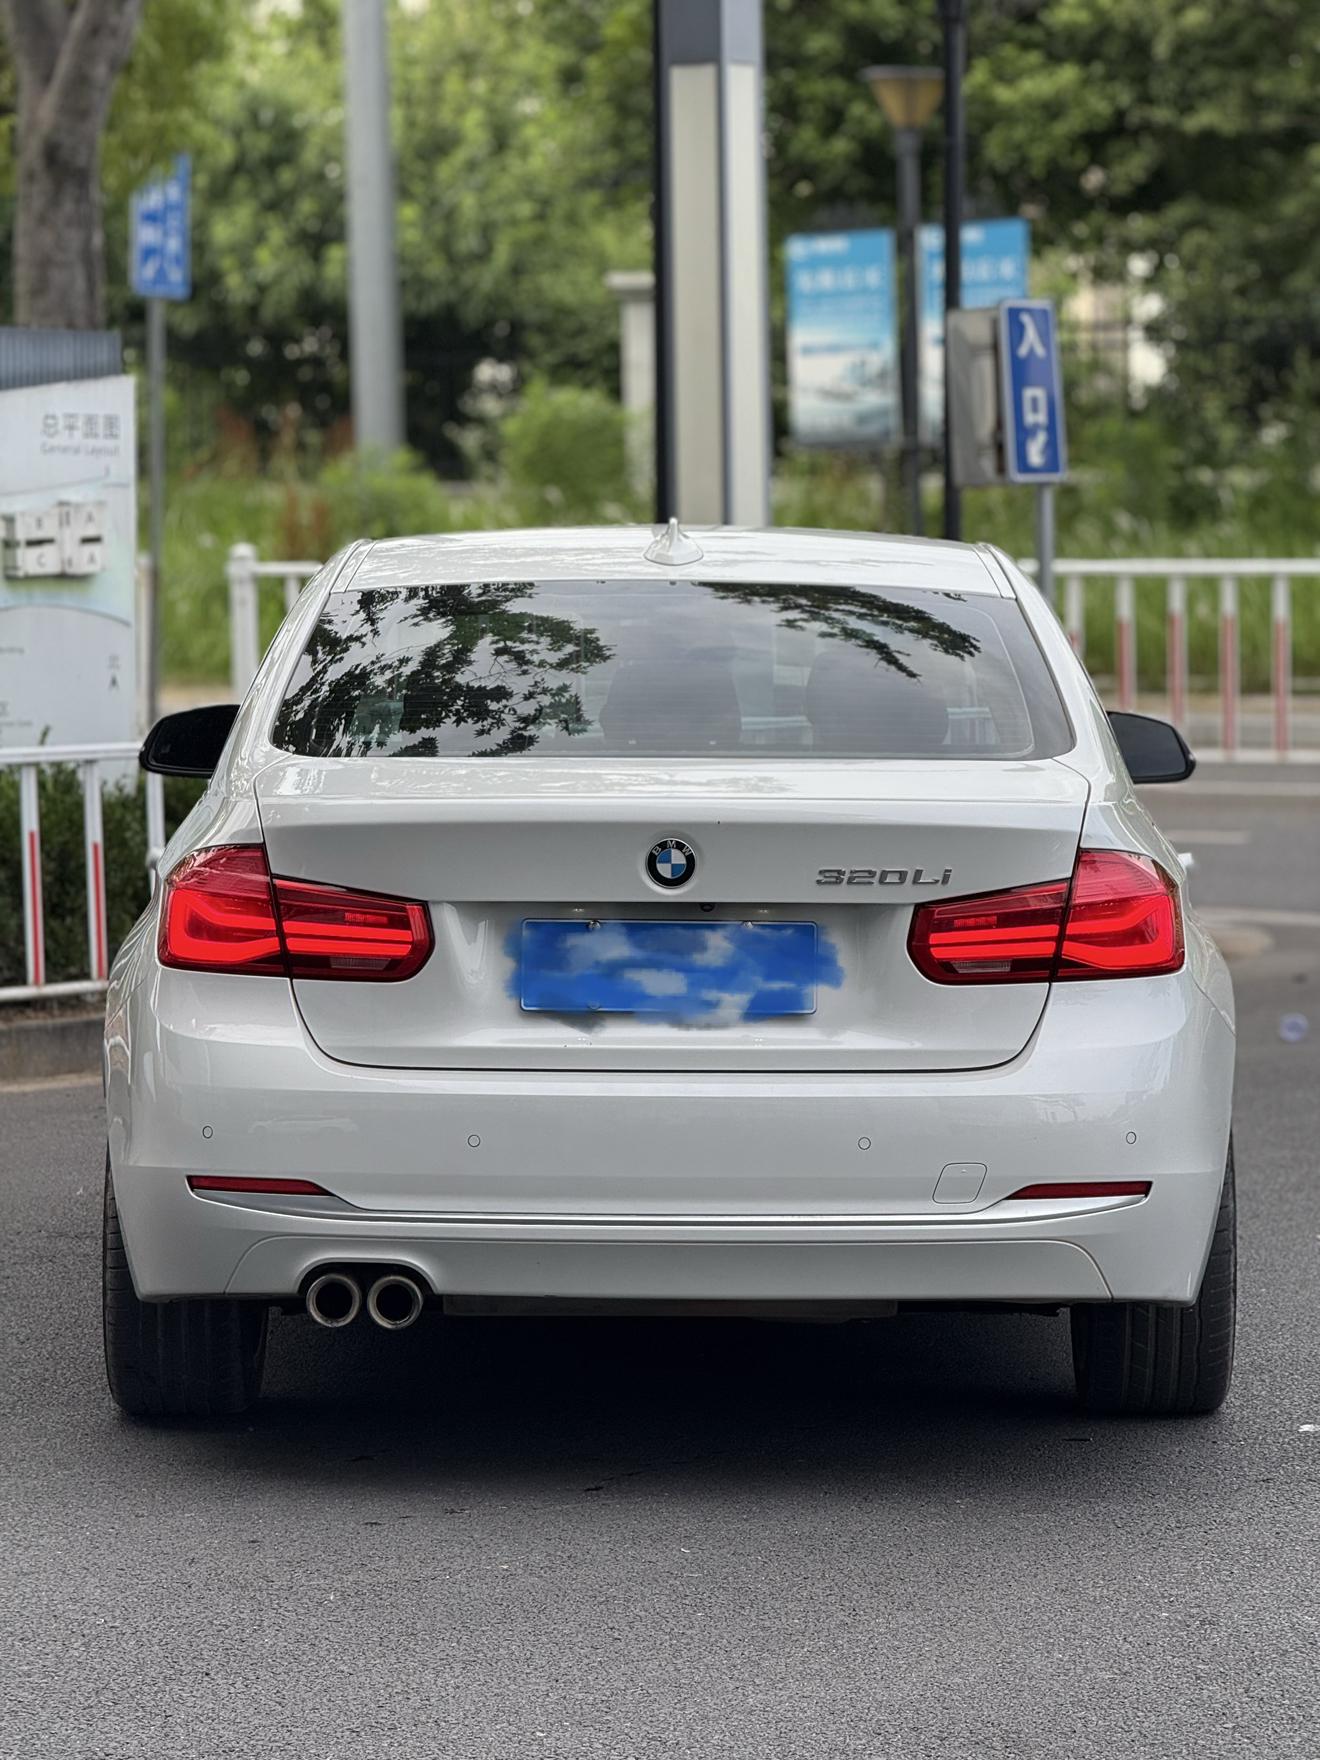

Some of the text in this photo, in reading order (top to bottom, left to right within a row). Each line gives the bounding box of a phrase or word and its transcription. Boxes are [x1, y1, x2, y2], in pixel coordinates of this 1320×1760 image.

[1017, 311, 1048, 428] 入口
[41, 412, 120, 440] 总平面图
[40, 441, 80, 456] General
[651, 840, 692, 856] BMW
[815, 868, 953, 886] 320Li
